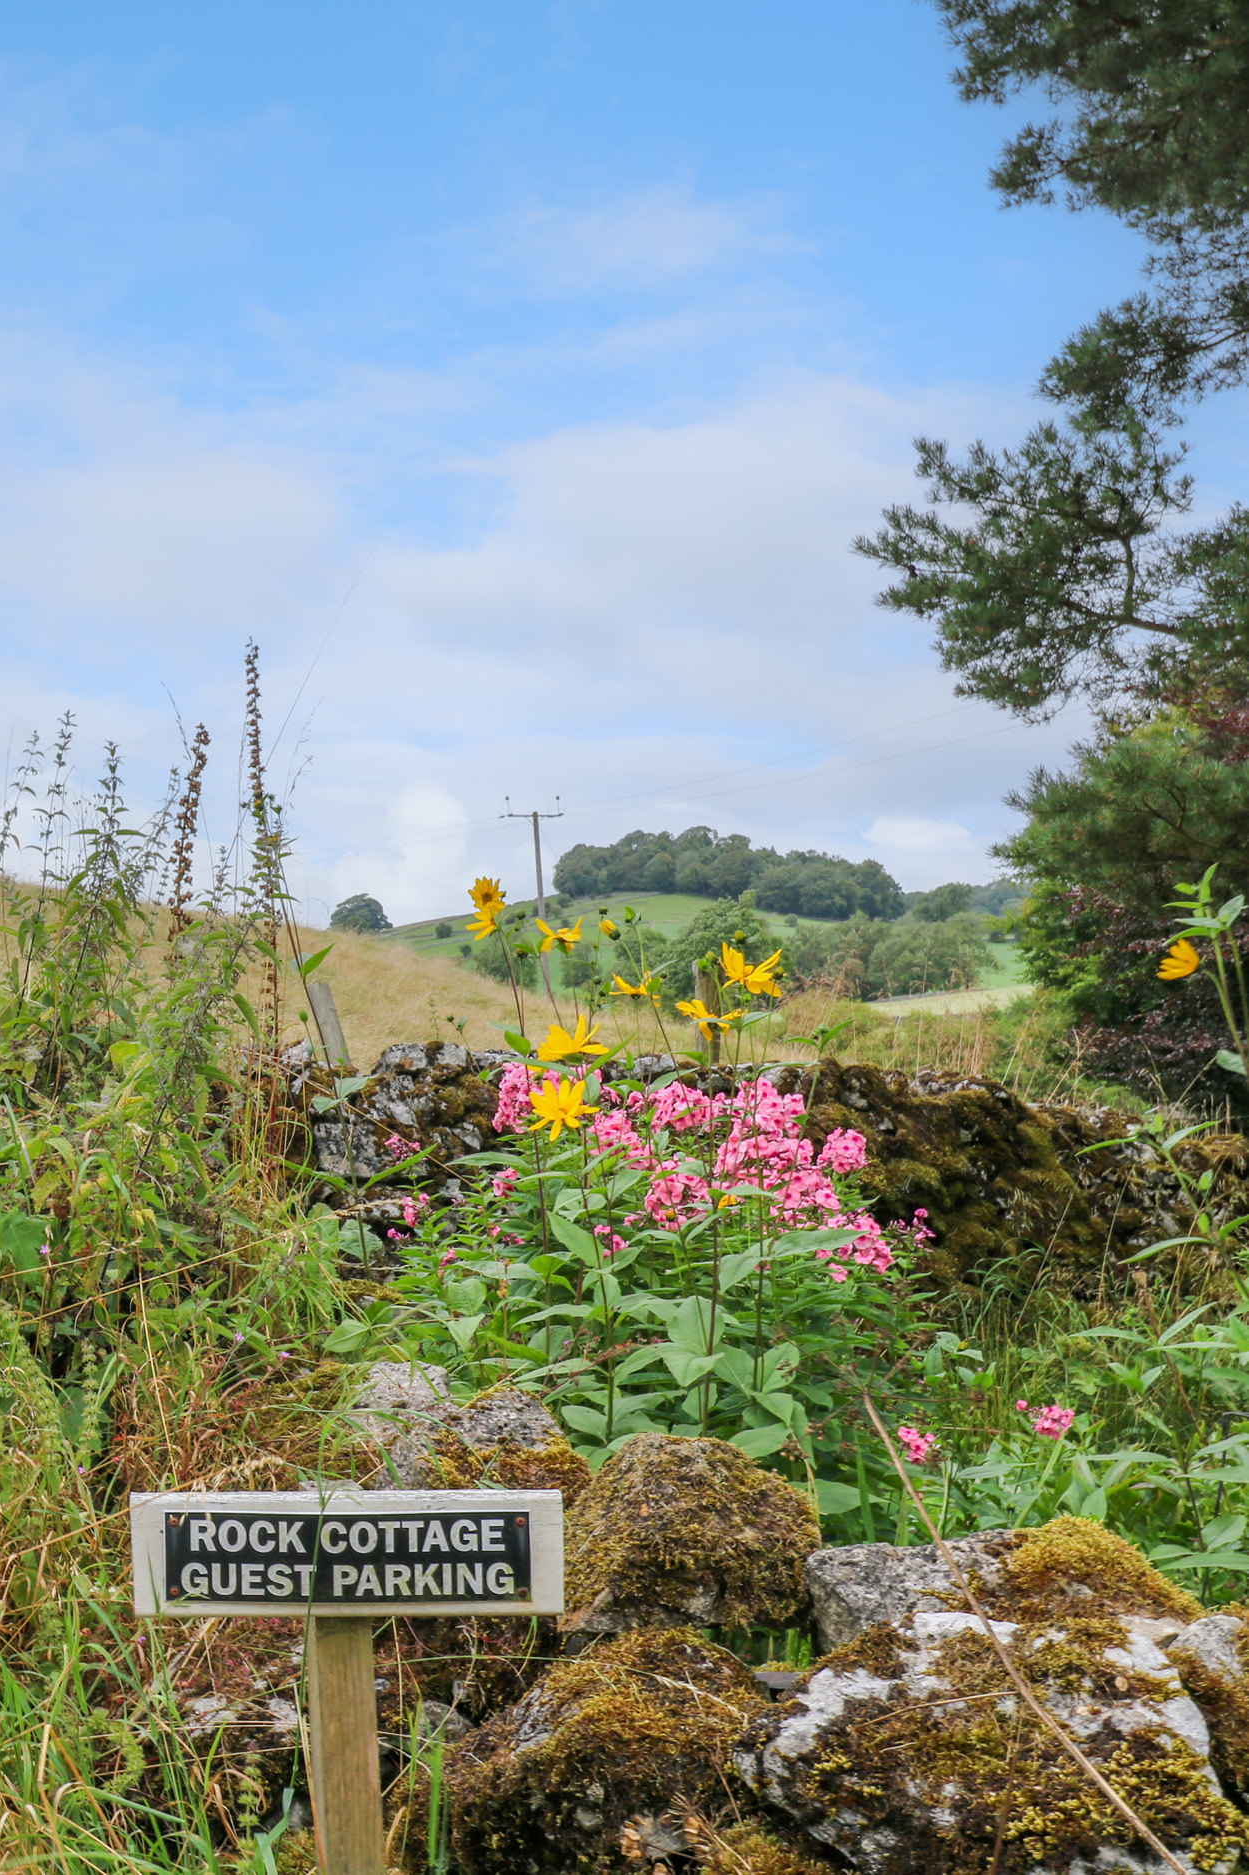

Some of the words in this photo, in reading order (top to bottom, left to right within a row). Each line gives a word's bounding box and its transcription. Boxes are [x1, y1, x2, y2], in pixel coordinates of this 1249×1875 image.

[189, 1518, 307, 1554] ROCK
[320, 1518, 506, 1555] COTTAGE
[180, 1562, 317, 1597] GUEST
[332, 1562, 515, 1598] PARKING
